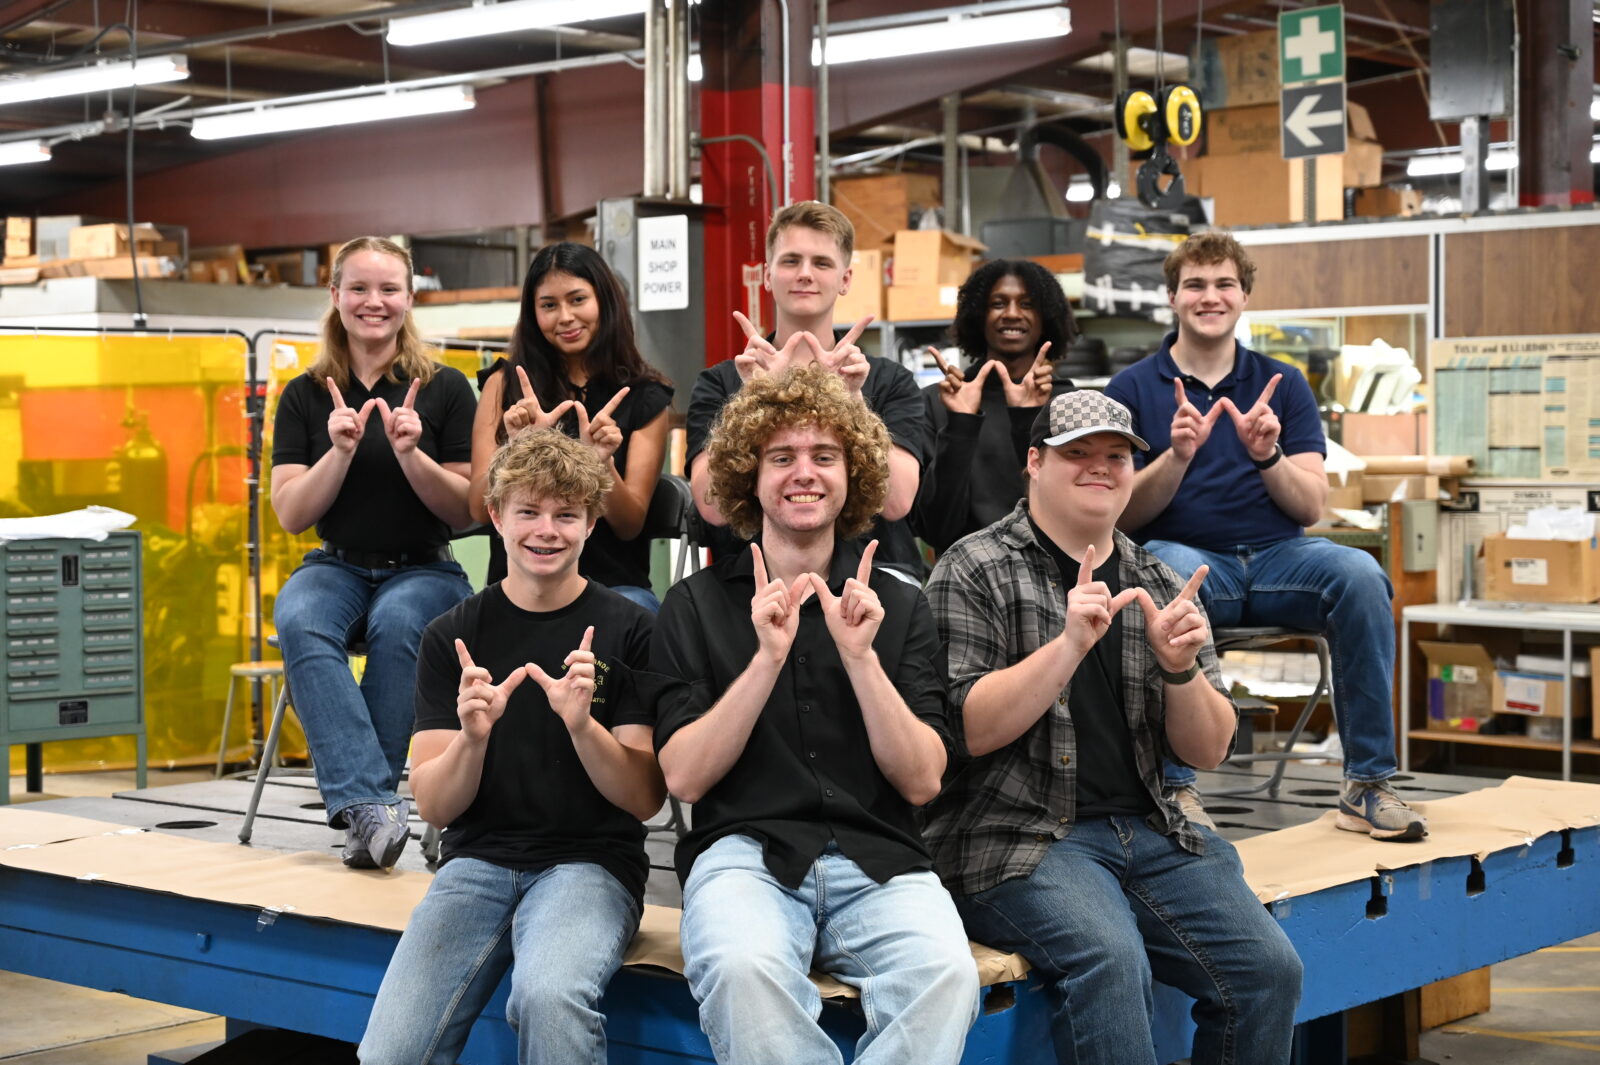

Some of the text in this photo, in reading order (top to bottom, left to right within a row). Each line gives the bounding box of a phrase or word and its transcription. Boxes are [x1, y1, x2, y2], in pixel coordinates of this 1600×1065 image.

[650, 239, 677, 250] MAIN
[648, 260, 678, 273] SHOP
[643, 281, 682, 294] POWER
[1482, 344, 1498, 353] and
